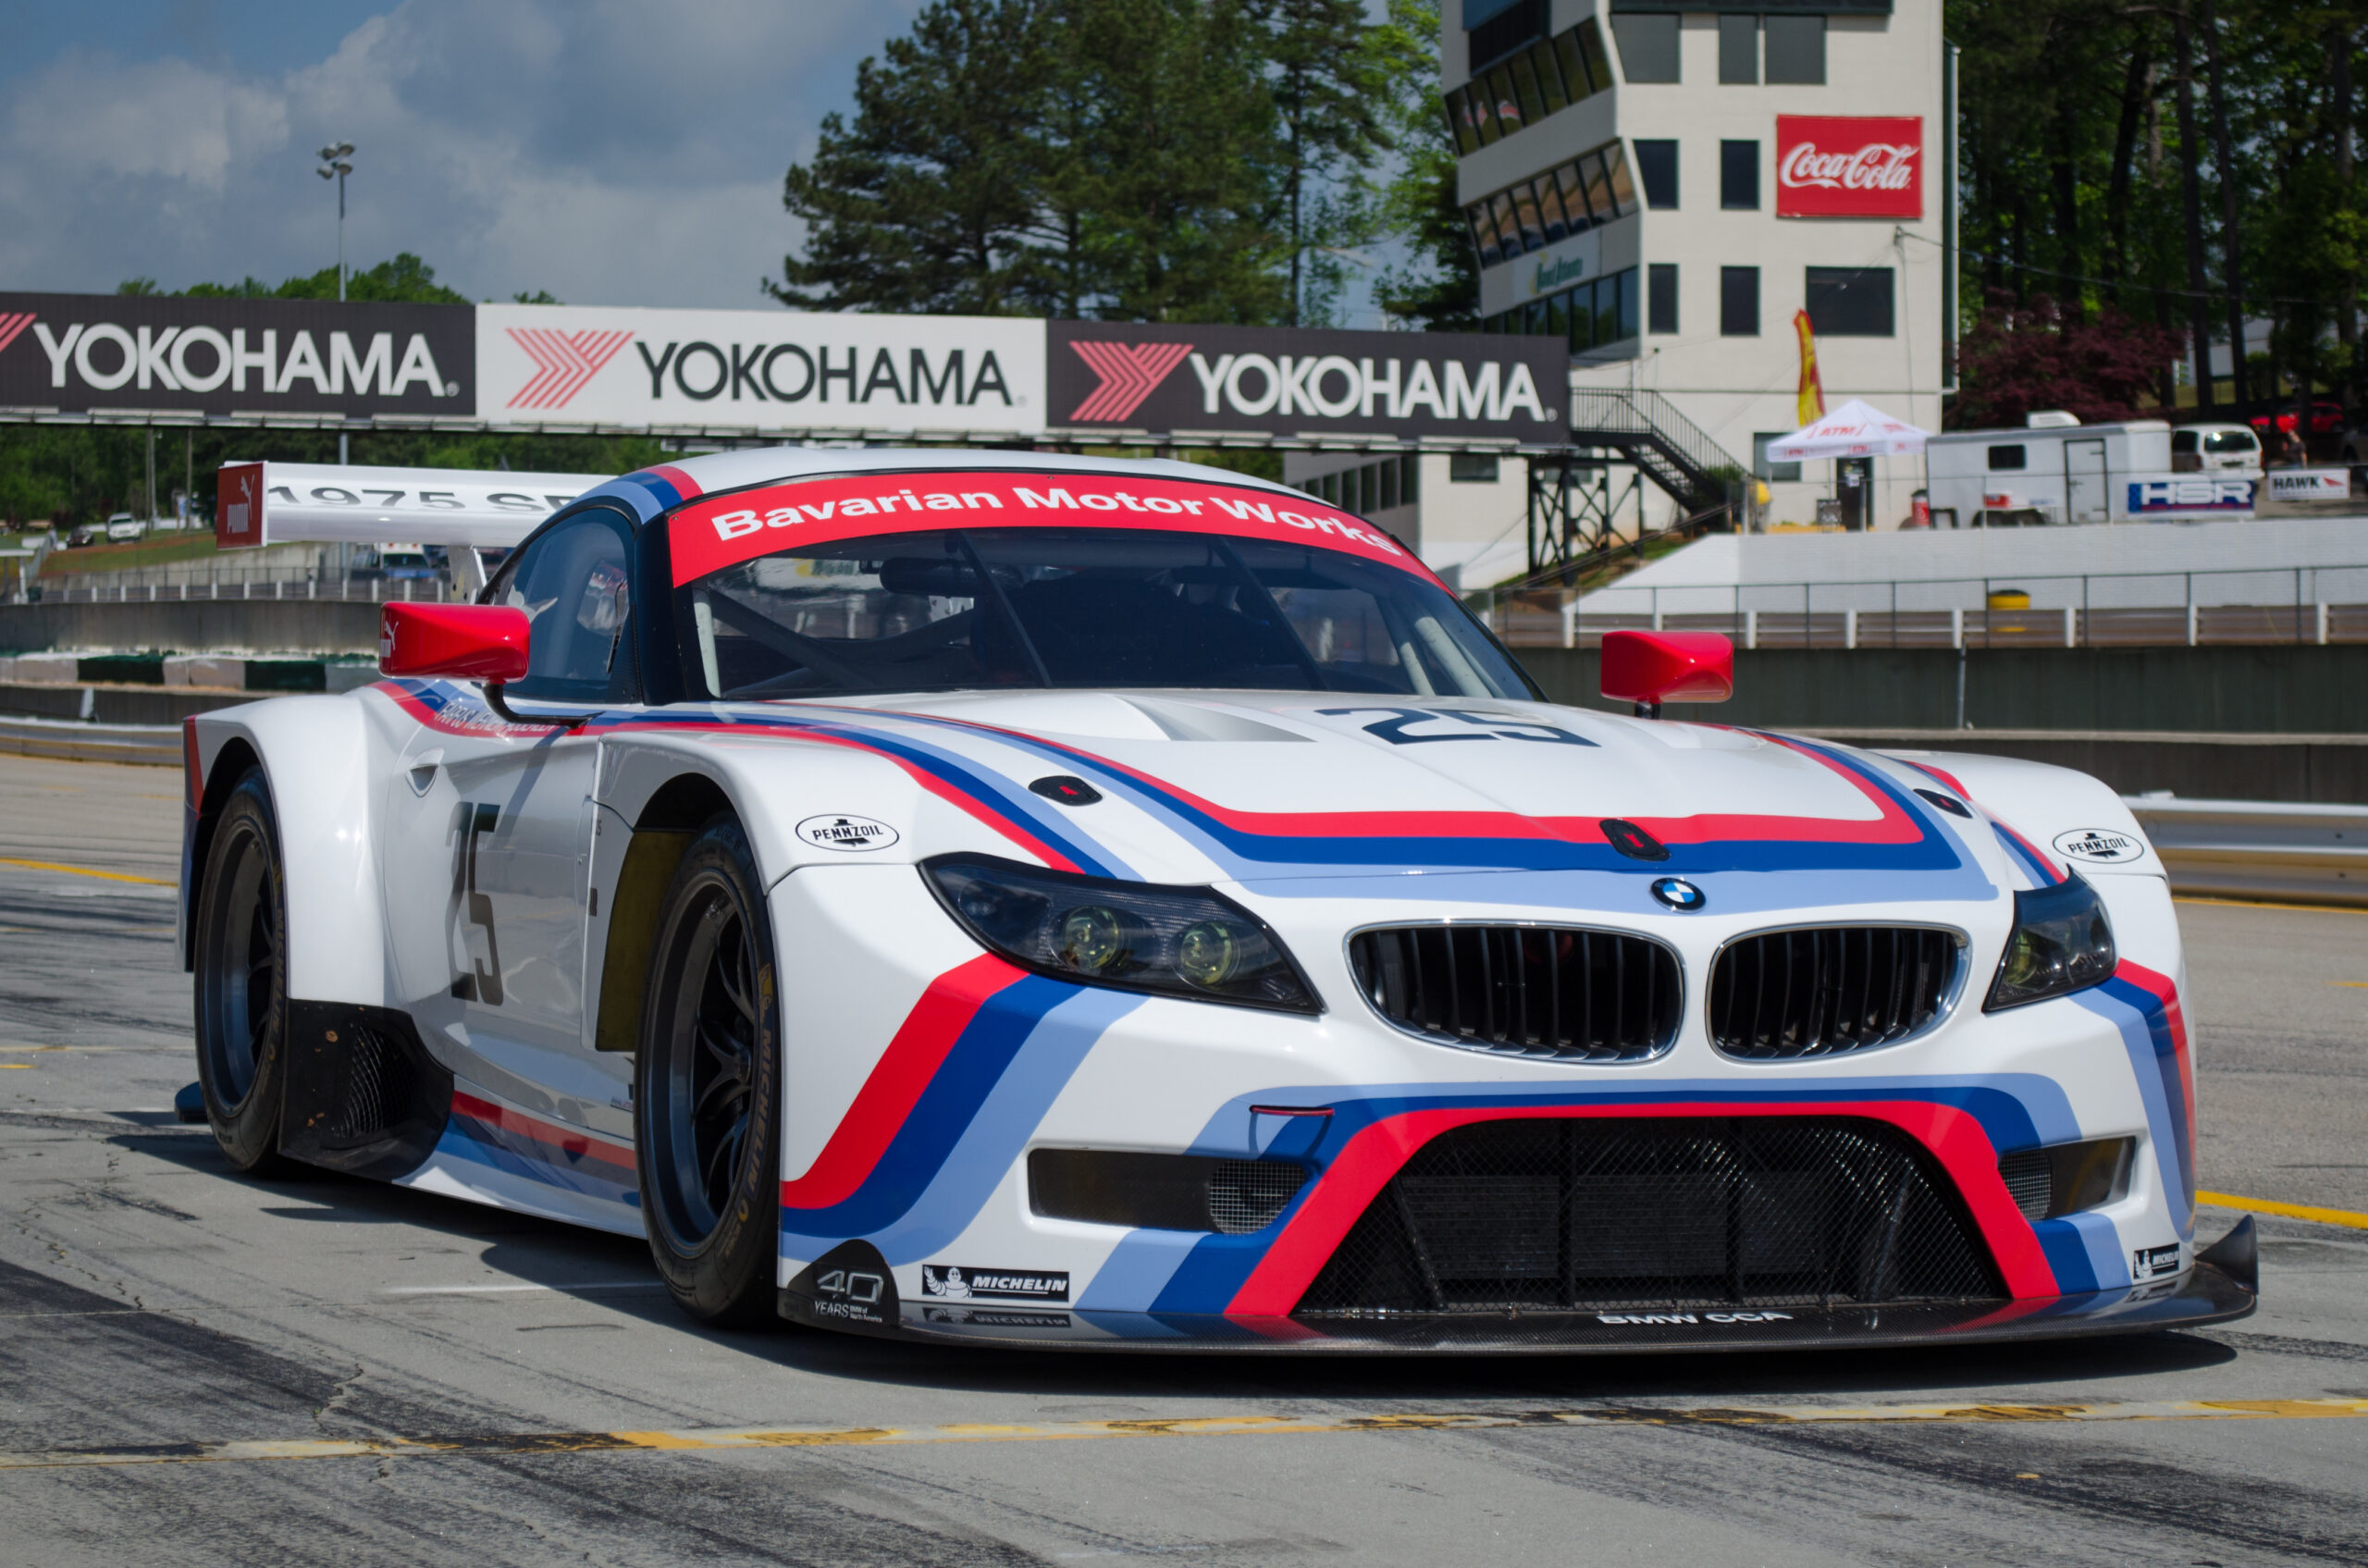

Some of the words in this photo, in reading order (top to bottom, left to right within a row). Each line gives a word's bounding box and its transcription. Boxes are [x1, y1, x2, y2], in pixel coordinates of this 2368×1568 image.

[1780, 142, 1920, 190] Coca-Cola
[32, 322, 446, 398] YOKOHAMA
[635, 340, 1014, 407] YOKOHAMA
[1188, 352, 1547, 422] YOKOHAMA
[268, 486, 467, 510] 1975
[2141, 480, 2251, 505] HSR
[2273, 476, 2321, 490] HAWK
[710, 488, 1005, 542] Bavarian
[1012, 487, 1203, 516] Motor
[1208, 496, 1403, 557] Works
[1314, 707, 1603, 747] 25
[811, 824, 884, 841] PENNZOIL
[2066, 836, 2130, 854] PENNZOIL
[445, 801, 504, 1007] 25
[747, 1030, 771, 1192] MICHELIN
[817, 1270, 884, 1304] 40
[972, 1276, 1067, 1291] MICHELIN
[814, 1301, 850, 1318] YEARS
[1597, 1314, 1699, 1325] BMW
[1705, 1312, 1794, 1323] CCA
